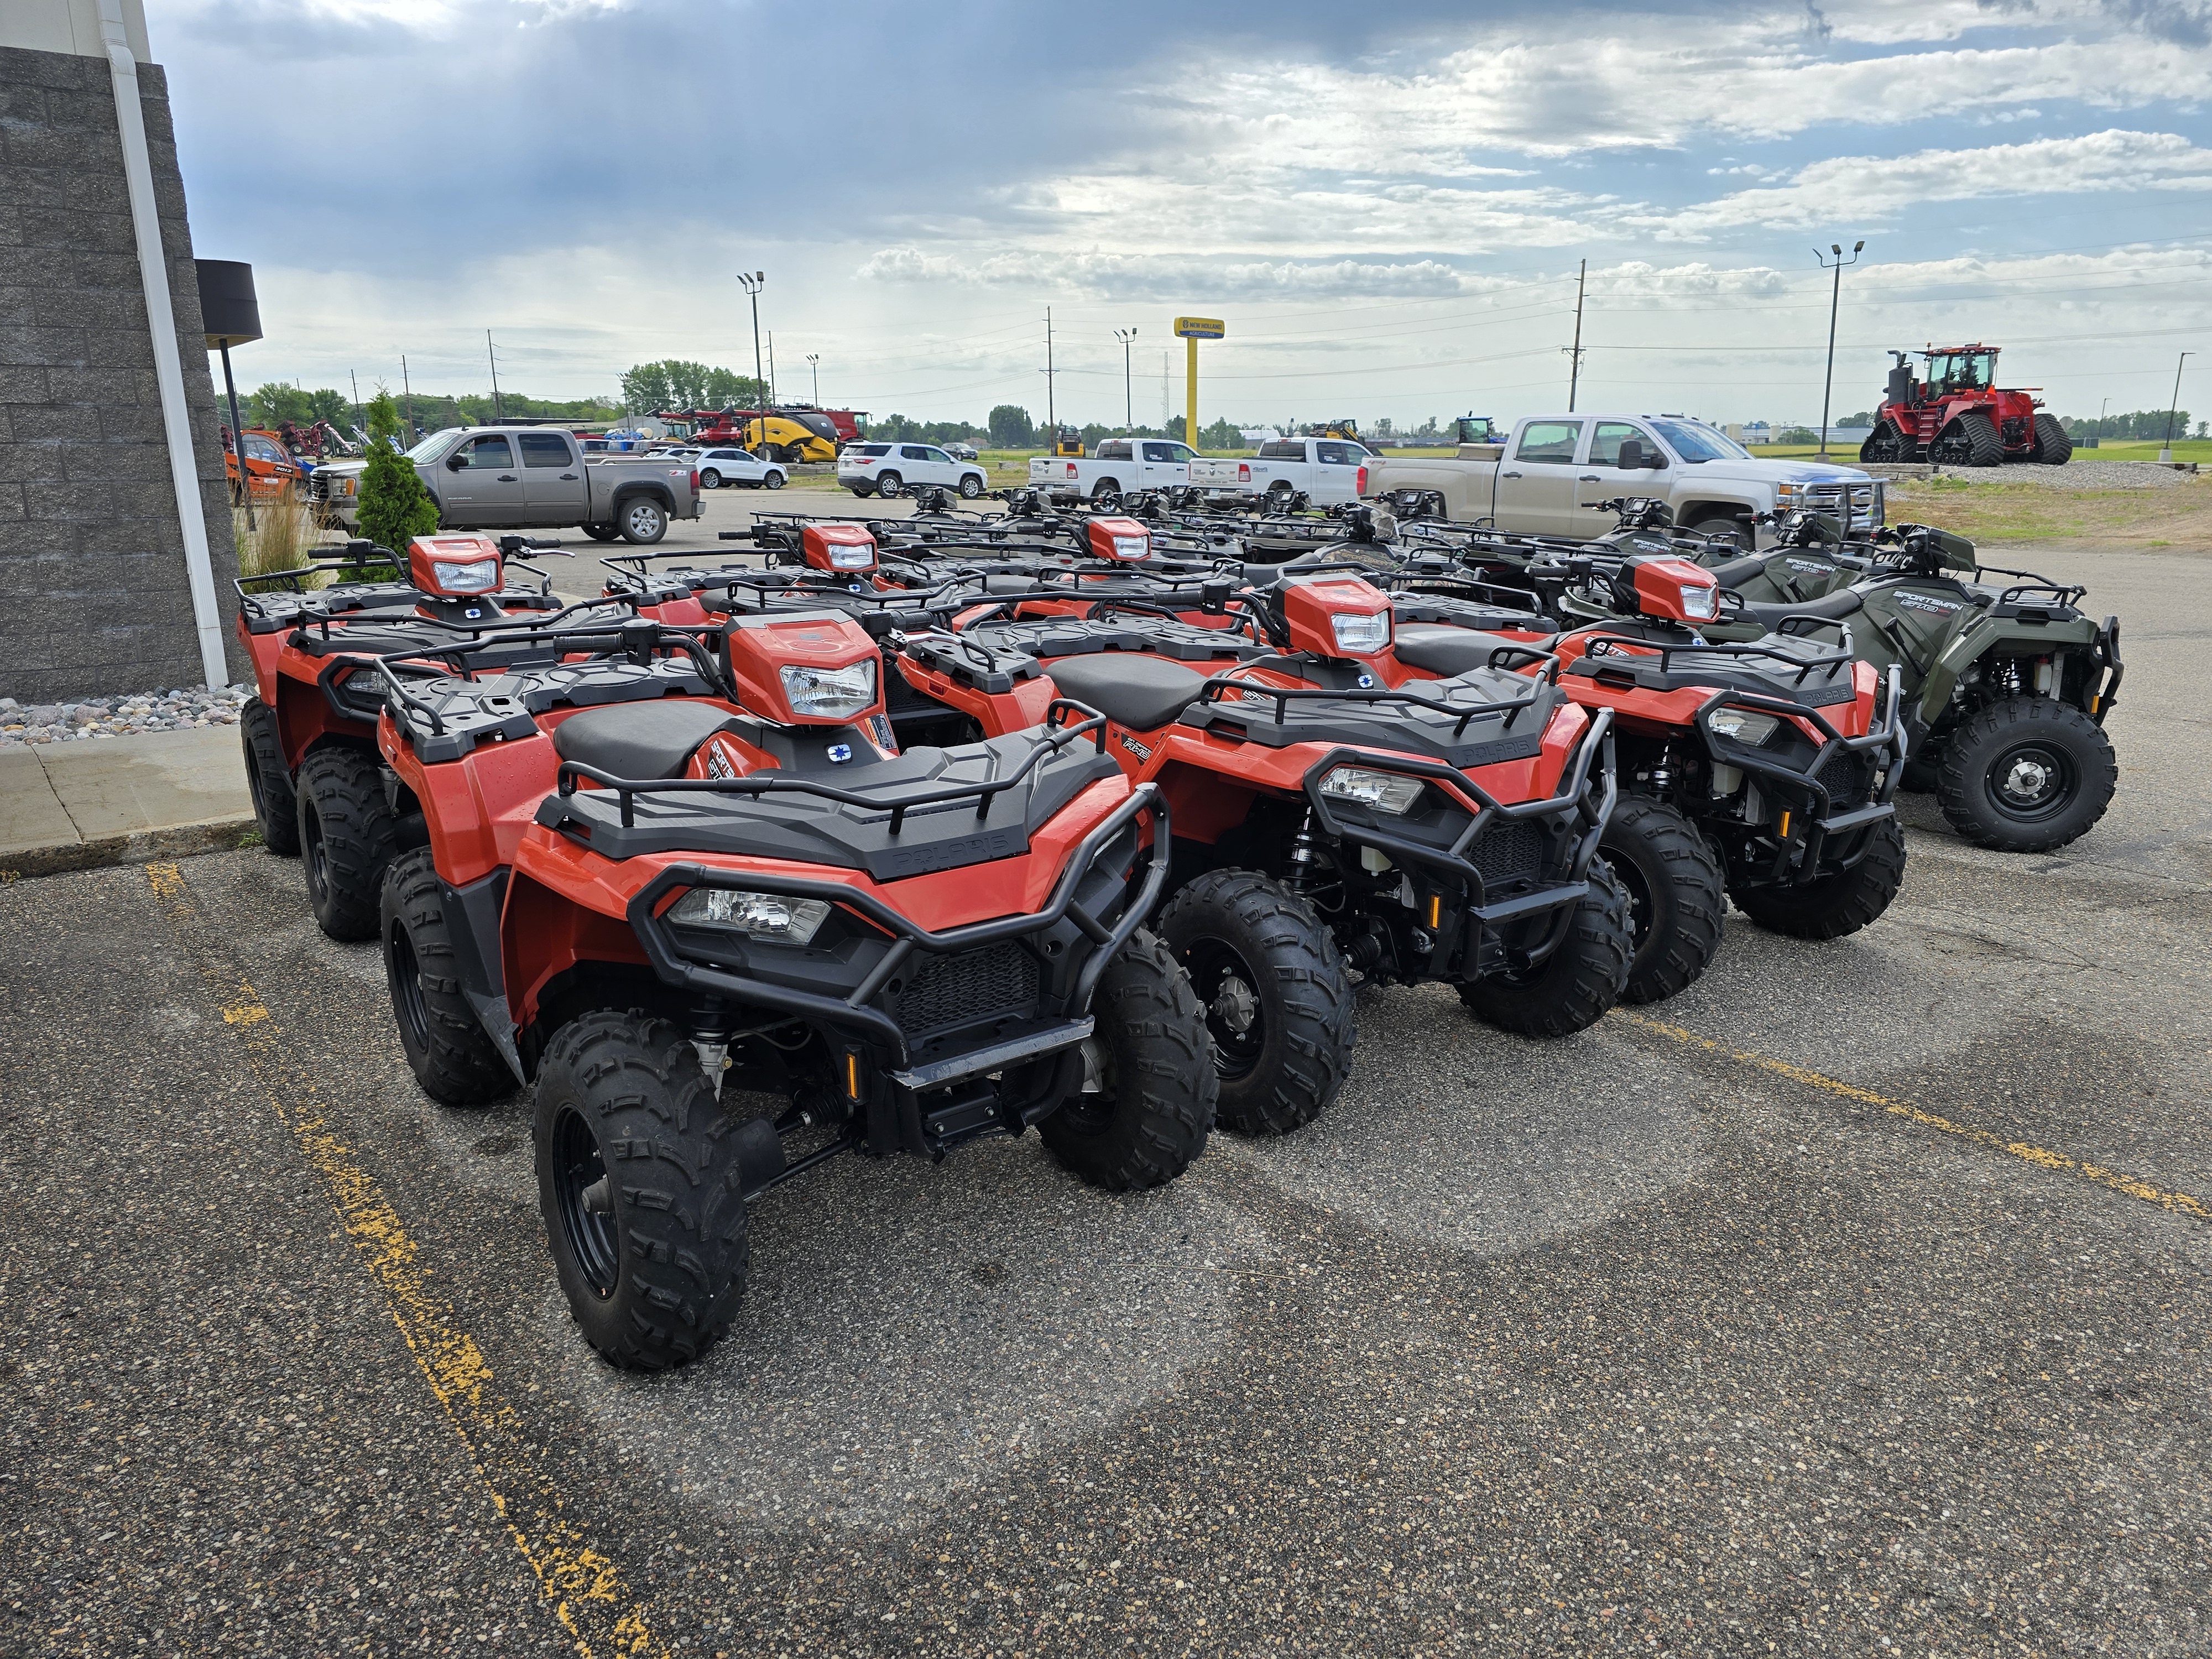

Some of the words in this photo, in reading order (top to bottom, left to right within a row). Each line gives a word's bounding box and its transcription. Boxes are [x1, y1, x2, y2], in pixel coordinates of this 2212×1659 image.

[1632, 539, 1672, 551] SPORTSMAN
[1341, 552, 1388, 566] SPORTSMAN
[1785, 557, 1837, 572] SPORTSMAN
[1791, 564, 1819, 574] 570
[1893, 591, 1964, 611] SPORTSMAN
[1900, 599, 1939, 613] 570
[472, 650, 549, 665] POLARIS
[1805, 687, 1849, 705] POLARIS
[1462, 740, 1530, 762] POLARIS
[711, 740, 735, 778] SPORTS
[893, 834, 1009, 872] POLARIS
